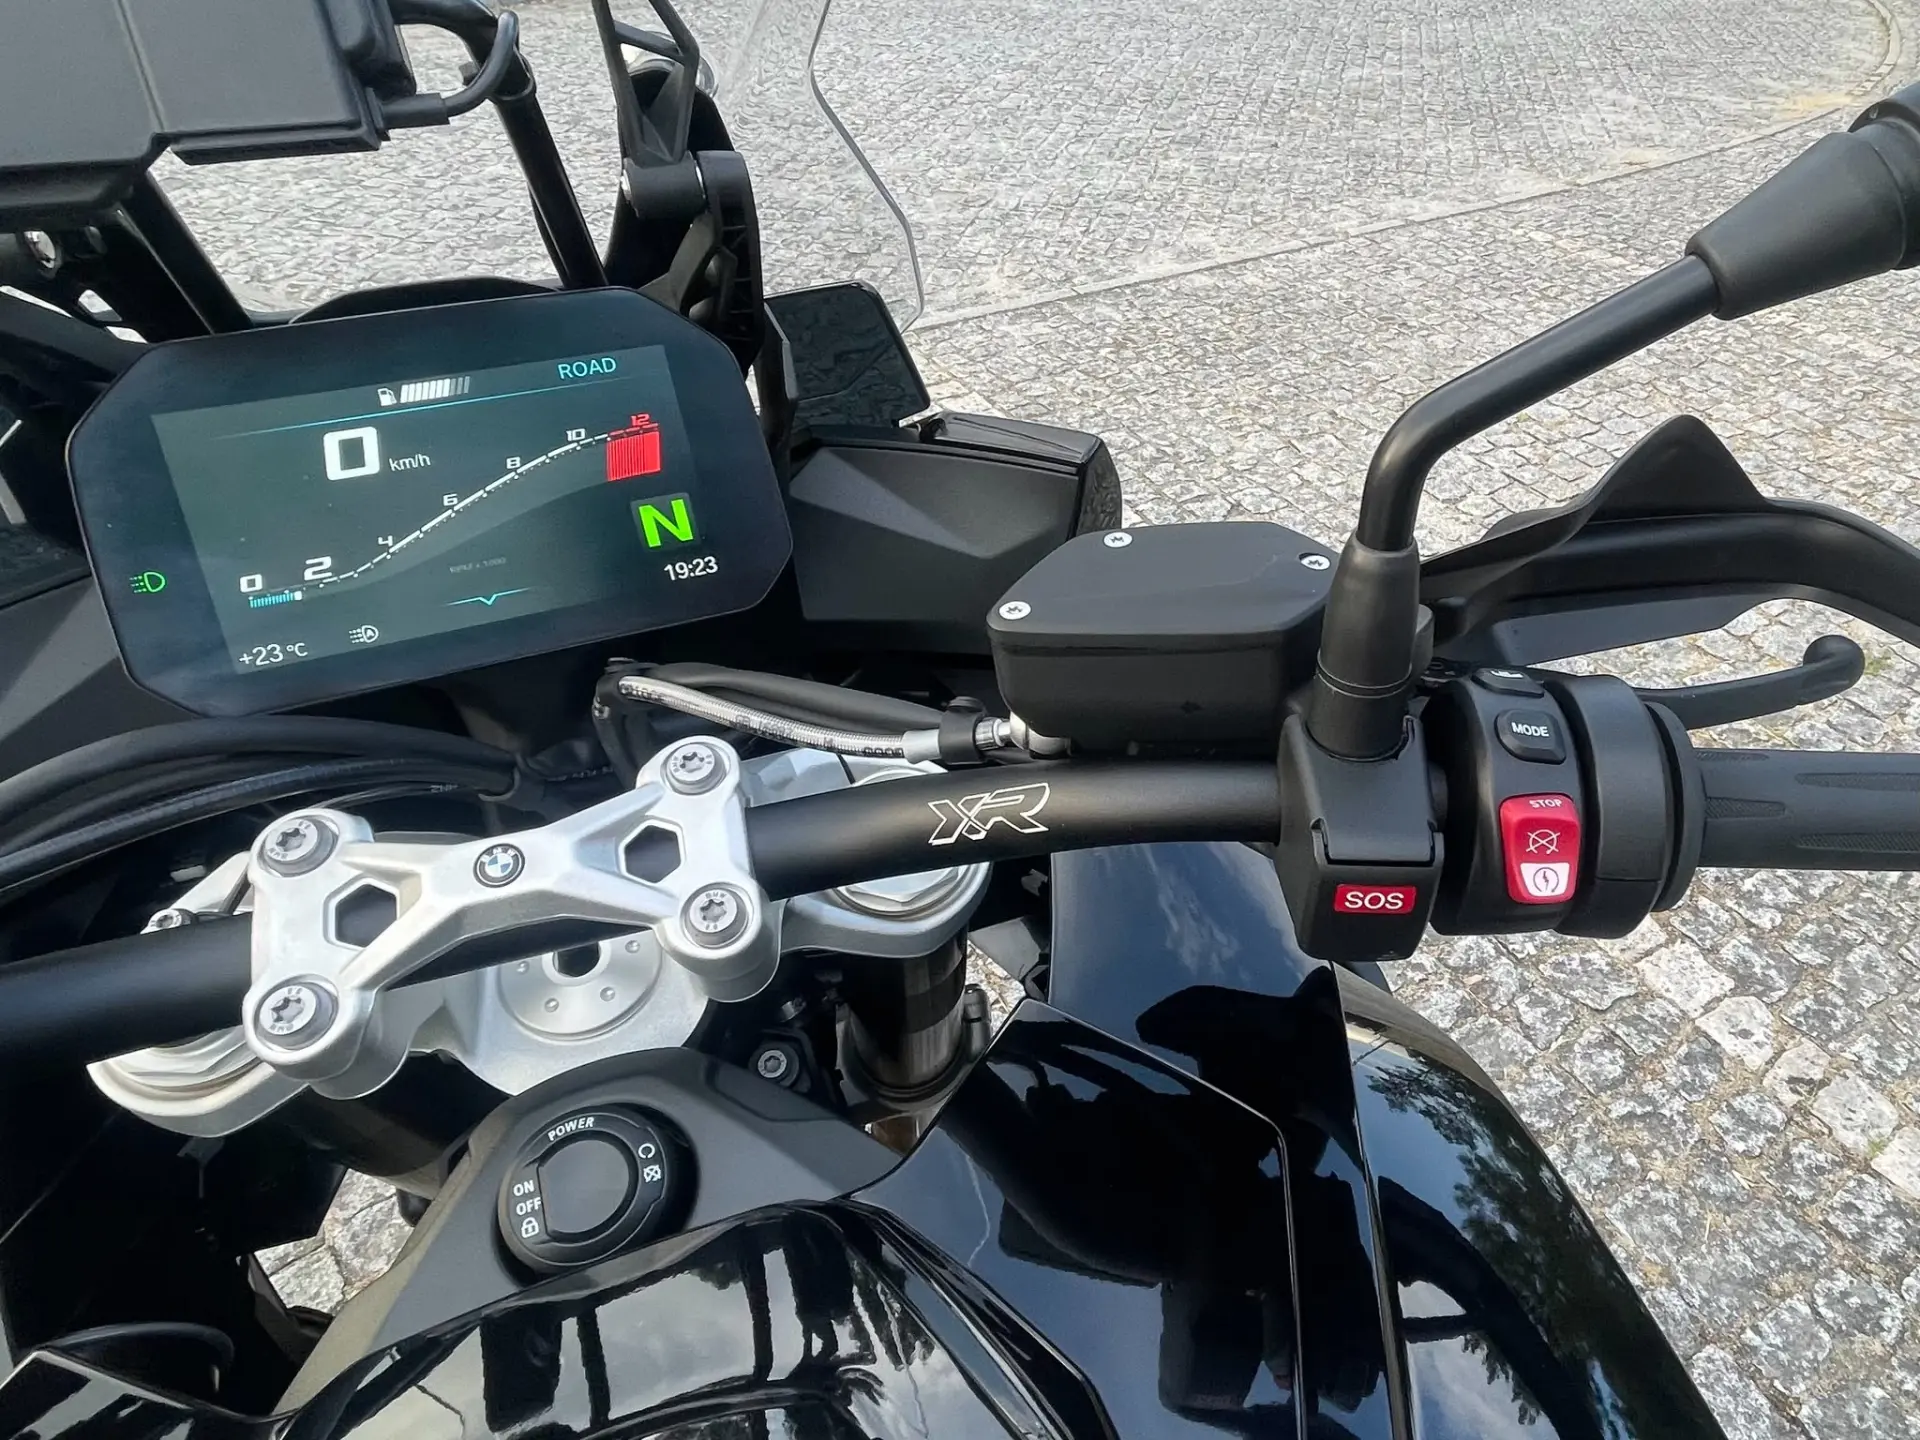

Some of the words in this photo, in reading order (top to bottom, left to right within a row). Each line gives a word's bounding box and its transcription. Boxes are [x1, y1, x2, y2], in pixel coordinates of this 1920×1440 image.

[557, 357, 617, 380] ROAD
[630, 413, 651, 426] 12
[566, 428, 587, 442] 10
[323, 426, 381, 481] 0
[388, 453, 432, 472] km/h
[506, 456, 521, 469] 8
[443, 493, 459, 506] 6
[638, 498, 694, 548] N
[377, 535, 394, 547] 4
[303, 555, 333, 581] 2
[663, 555, 719, 581] 19:23
[239, 573, 263, 593] 0
[239, 643, 284, 666] +23
[1510, 721, 1550, 737] MODE
[927, 782, 1051, 846] XR
[1529, 799, 1563, 809] STOP
[1343, 890, 1405, 910] SOS
[547, 1116, 595, 1142] POWER
[512, 1179, 535, 1197] ON
[515, 1196, 542, 1216] OFF
